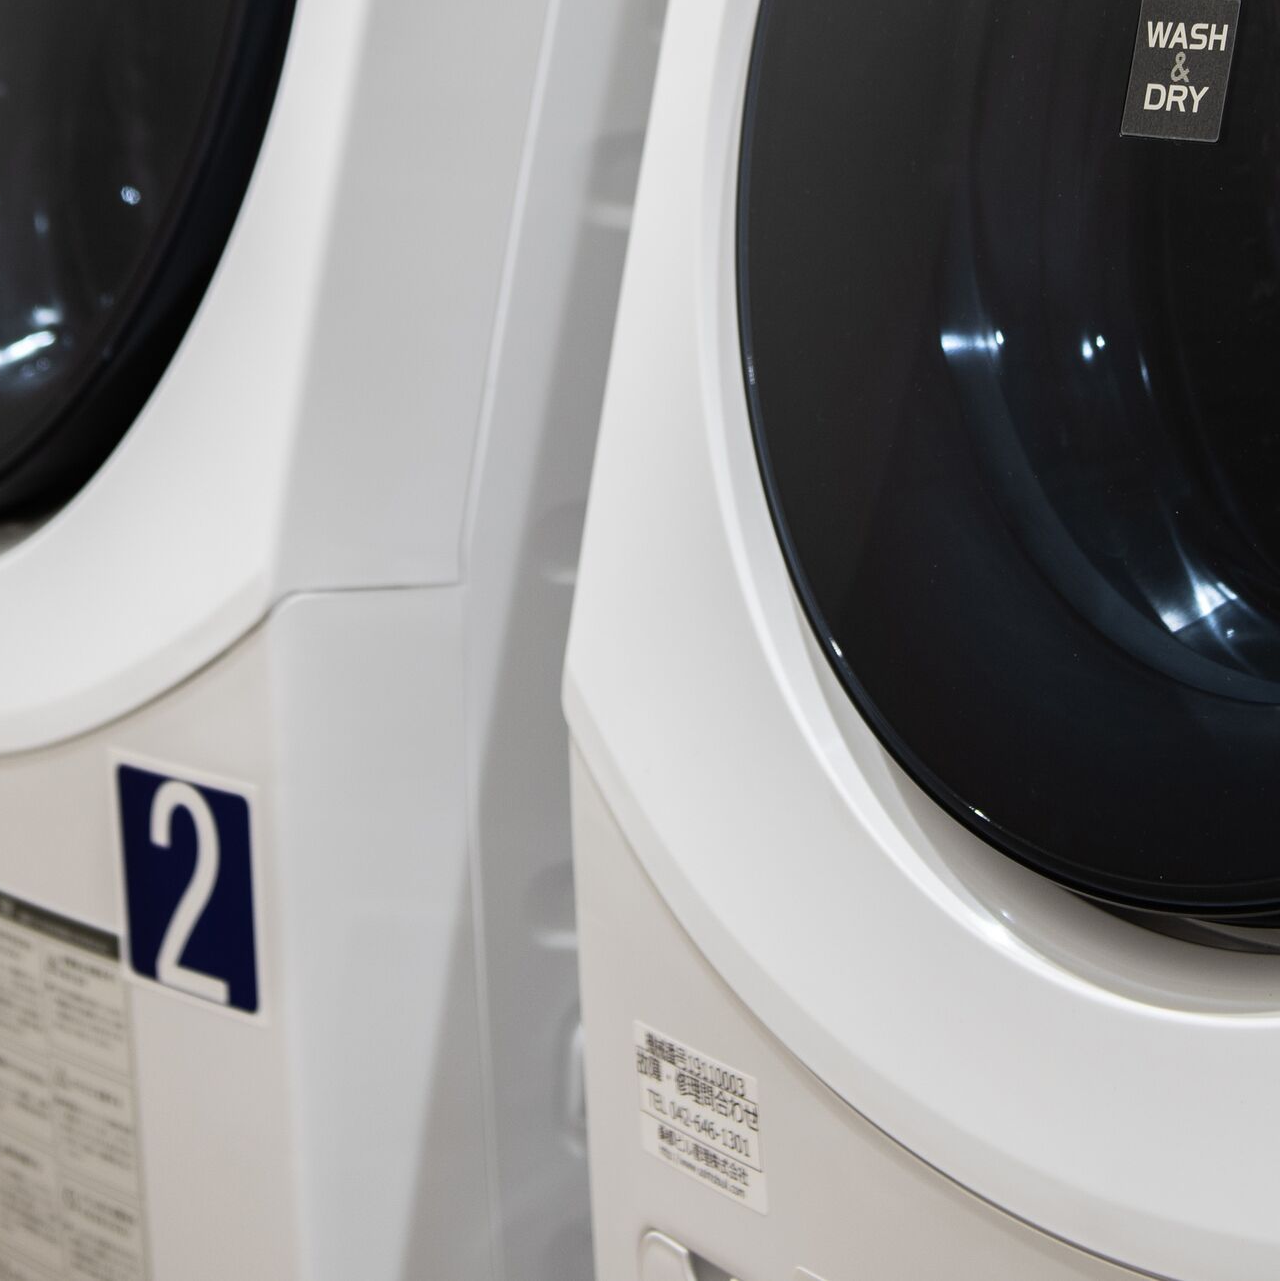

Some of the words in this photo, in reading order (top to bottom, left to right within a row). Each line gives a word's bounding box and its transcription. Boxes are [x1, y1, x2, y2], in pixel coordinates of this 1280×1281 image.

[1147, 21, 1229, 51] WASH
[1170, 51, 1190, 83] &
[1143, 83, 1210, 113] DRY
[149, 780, 230, 1005] 2
[647, 1088, 667, 1116] TEL
